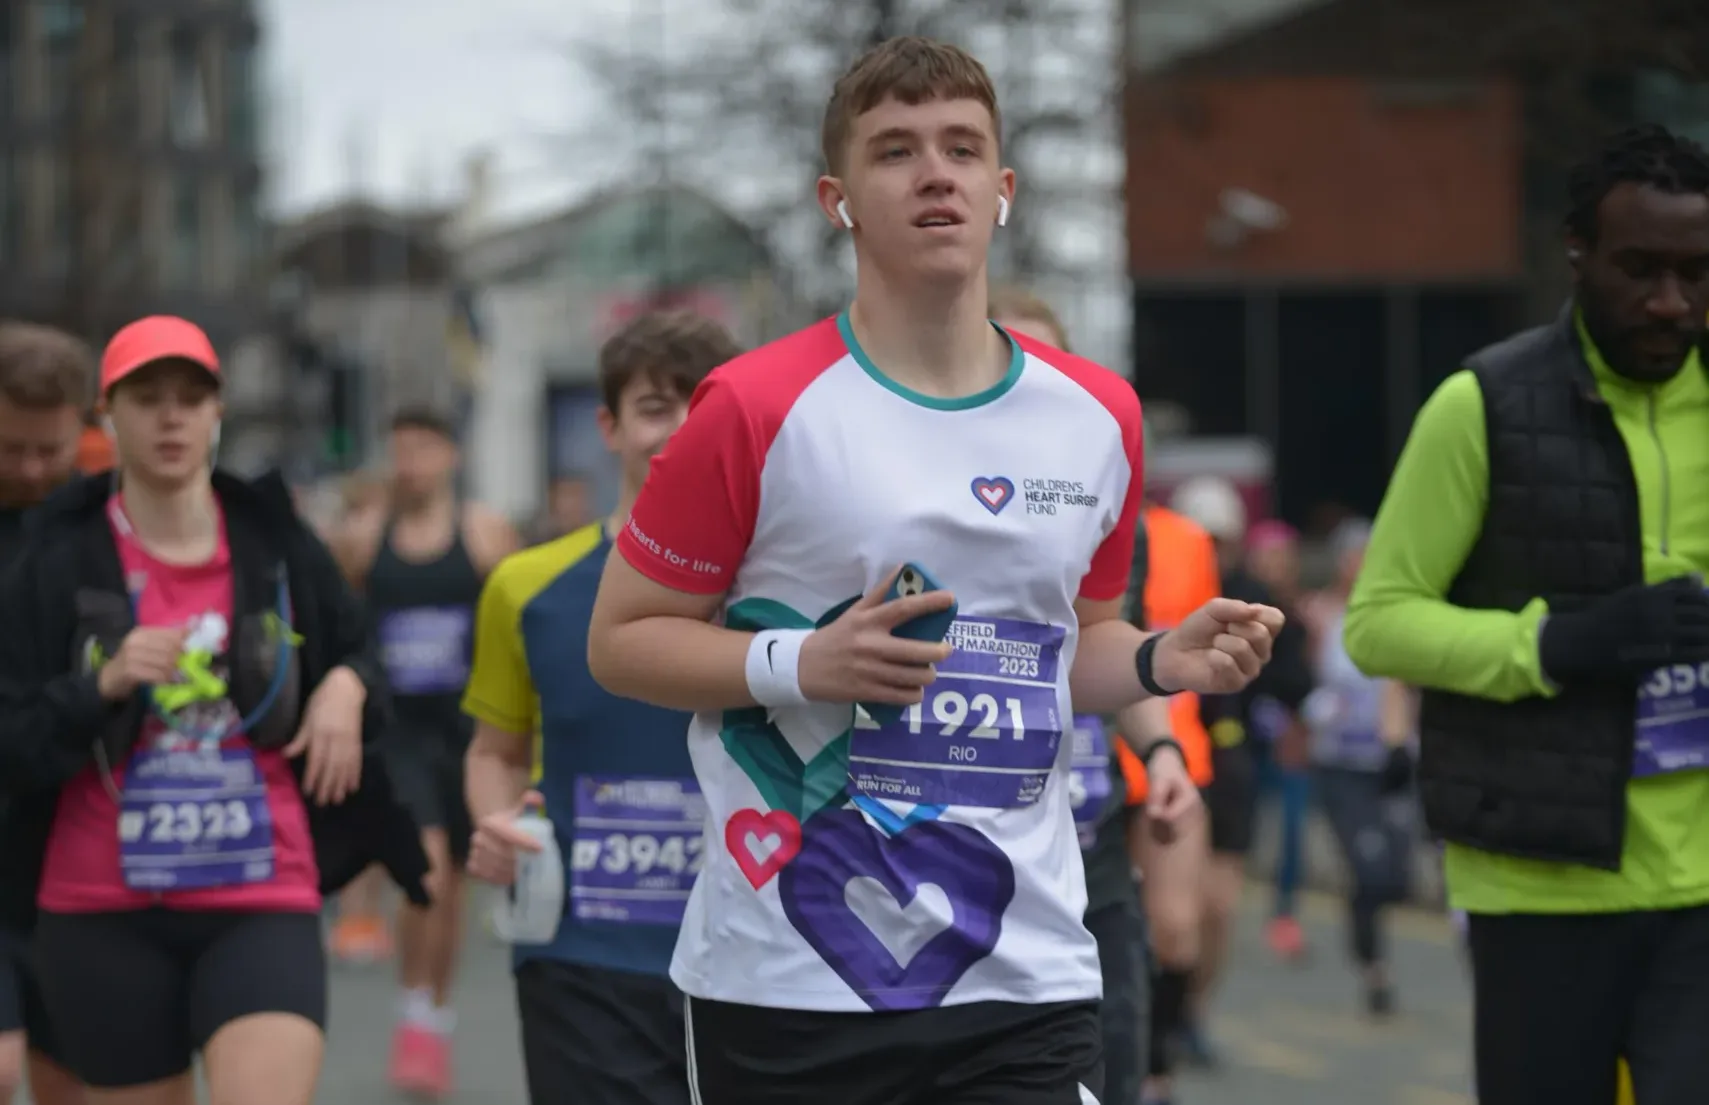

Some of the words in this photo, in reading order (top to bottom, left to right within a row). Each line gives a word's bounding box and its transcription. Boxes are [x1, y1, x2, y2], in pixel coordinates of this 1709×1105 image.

[1023, 478, 1084, 493] CHILDREN'S
[1025, 491, 1061, 504] HEART
[1026, 503, 1057, 516] FUND
[629, 518, 661, 555] hearts
[664, 548, 688, 567] for
[693, 559, 721, 574] life
[965, 638, 1038, 657] MARATHON
[998, 656, 1039, 678] 2023
[908, 691, 1024, 740] 1921
[948, 745, 977, 762] RIO
[856, 779, 879, 791] RUN
[880, 782, 902, 794] FOR
[903, 785, 922, 797] ALL
[601, 833, 704, 874] 3942
